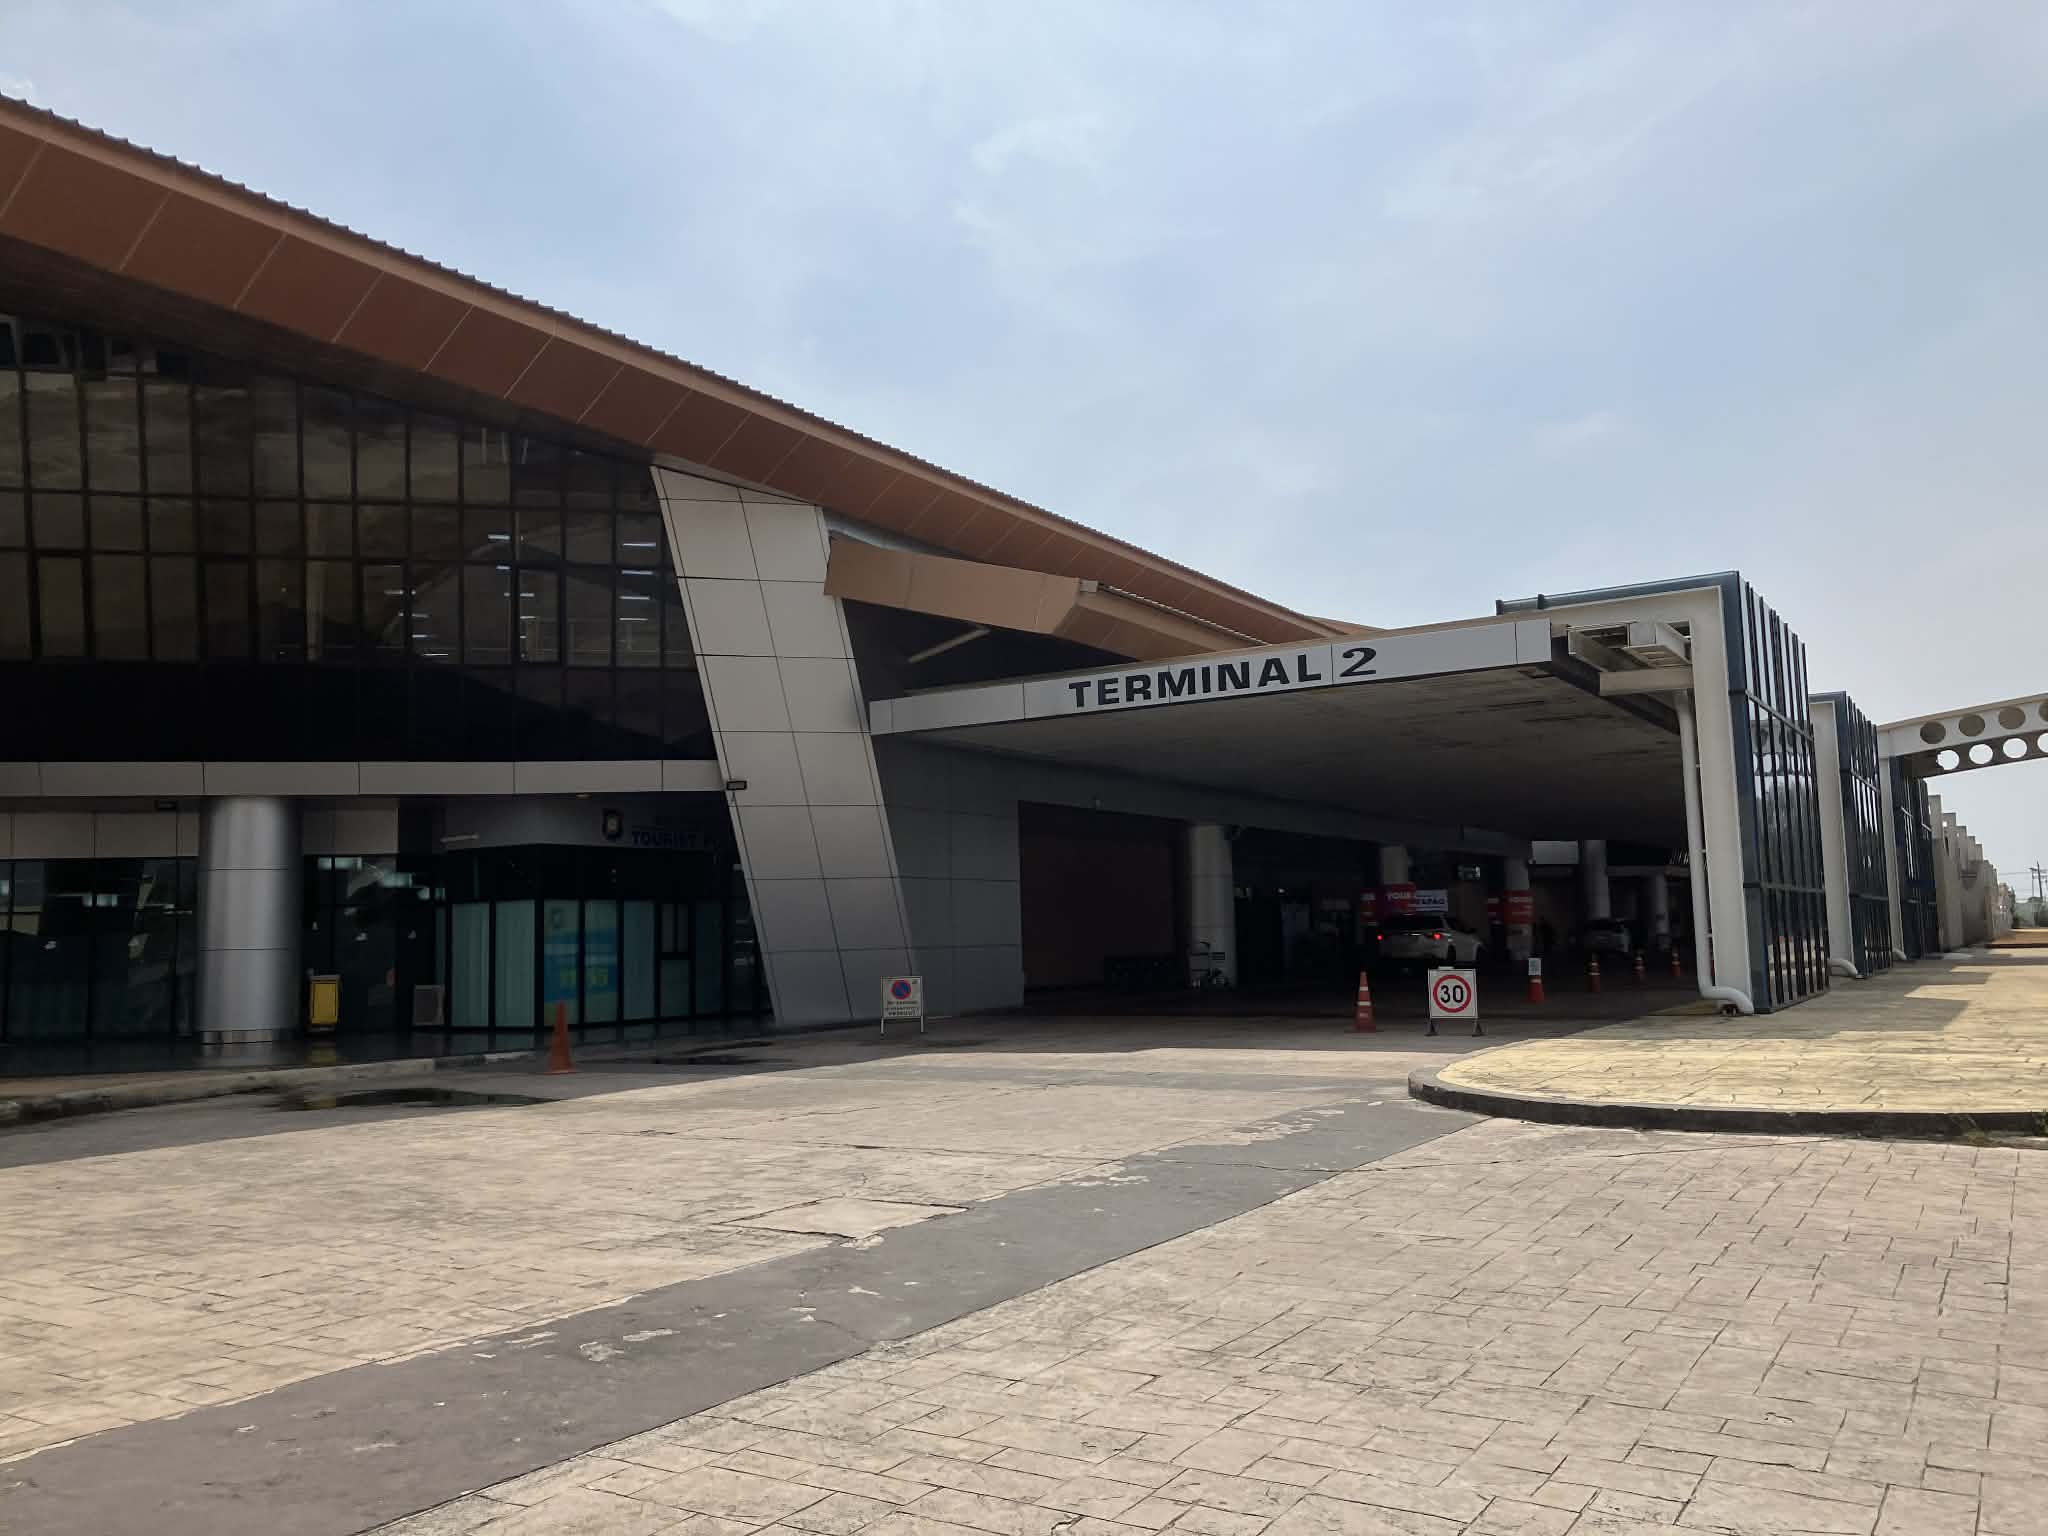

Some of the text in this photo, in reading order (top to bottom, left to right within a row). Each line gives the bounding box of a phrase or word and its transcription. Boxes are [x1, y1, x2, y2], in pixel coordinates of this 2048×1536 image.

[1069, 647, 1378, 708] TERMINAL 2
[1440, 985, 1464, 1004] 30
